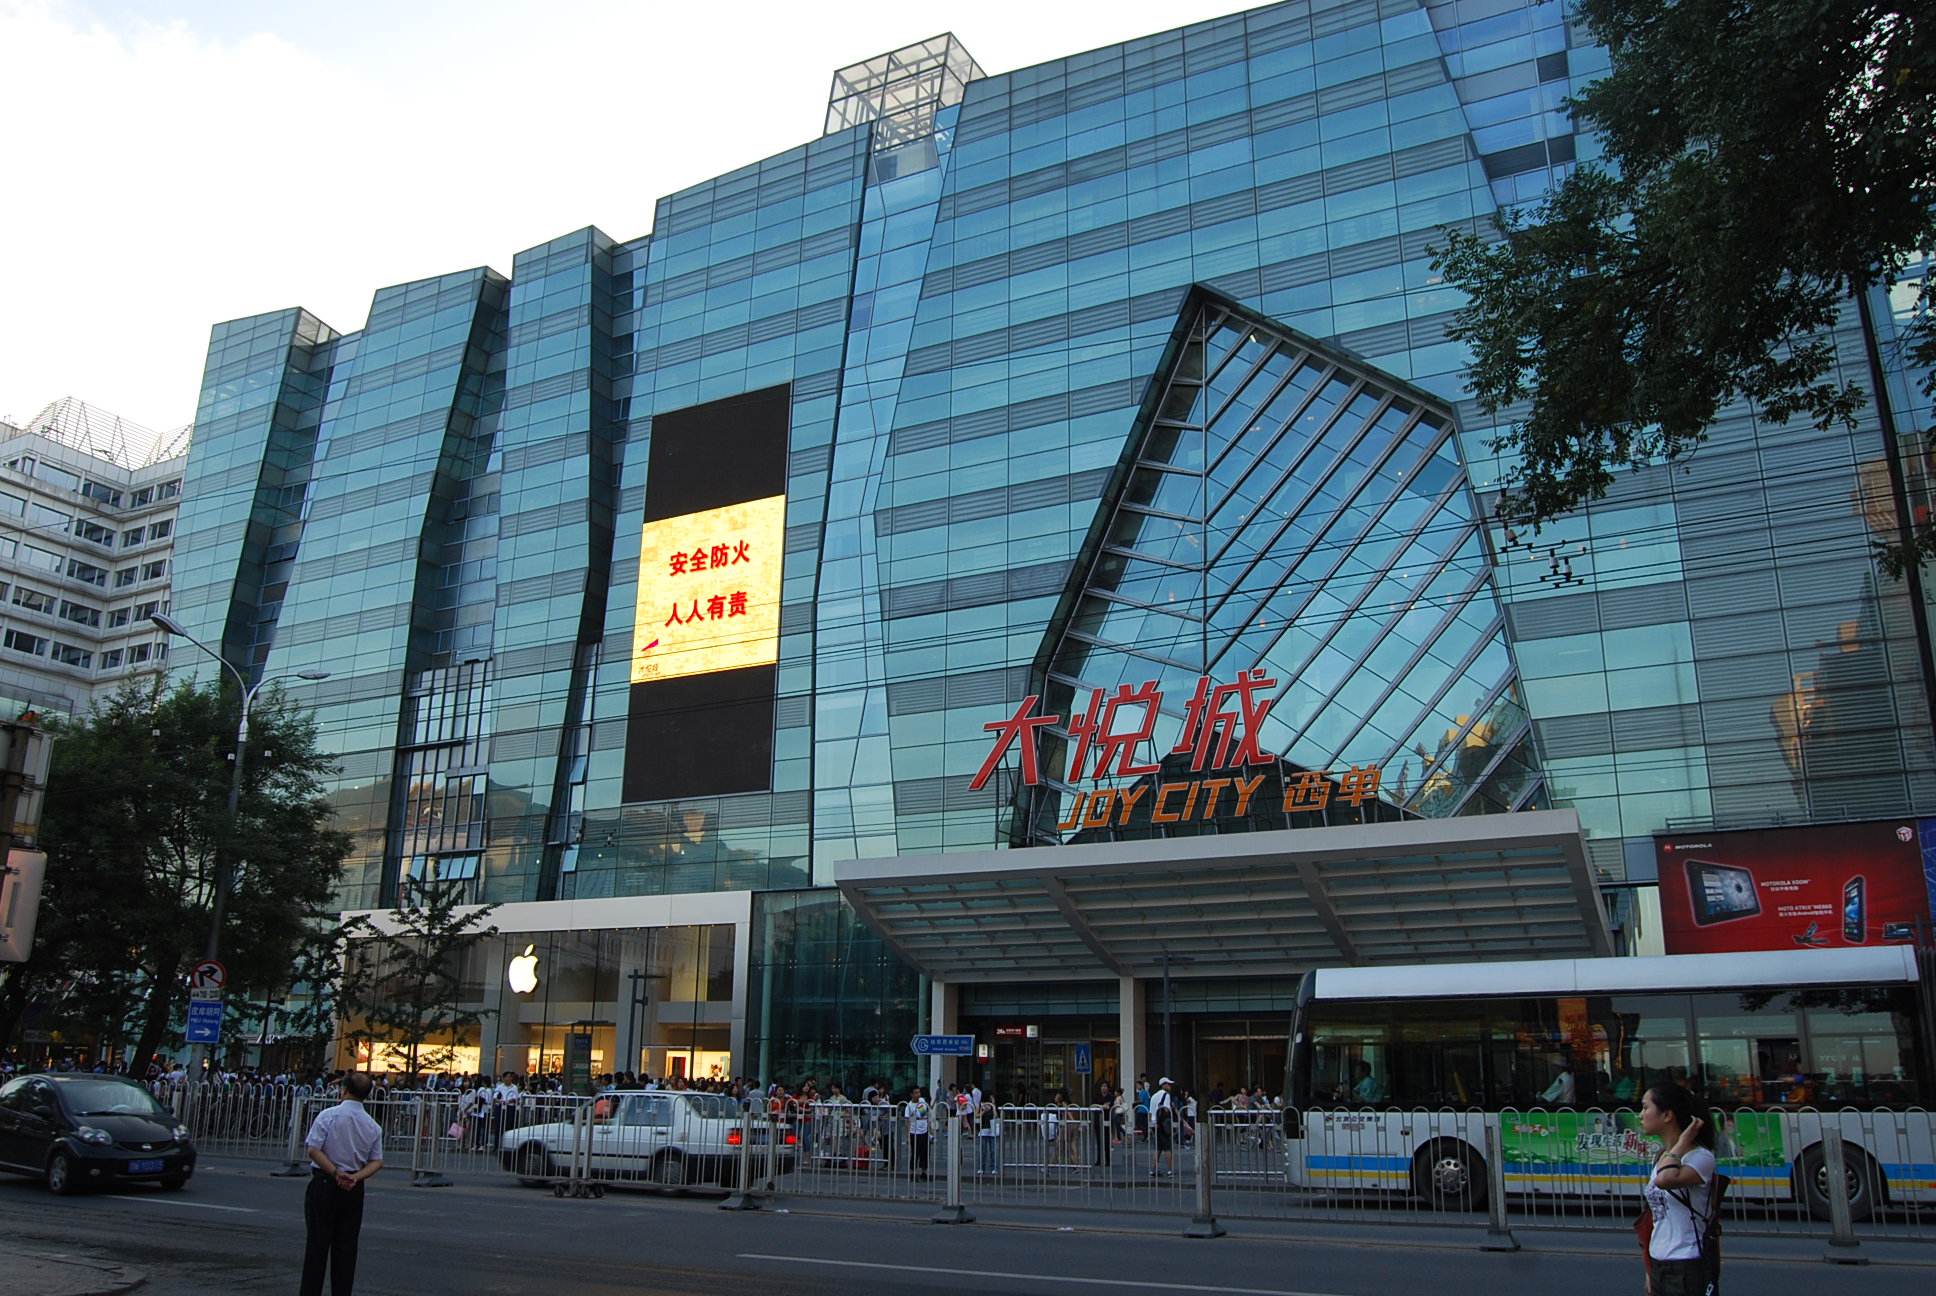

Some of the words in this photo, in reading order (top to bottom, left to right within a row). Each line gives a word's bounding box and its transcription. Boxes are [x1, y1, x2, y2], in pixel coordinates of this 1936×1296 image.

[669, 540, 749, 577] 安全防火
[665, 591, 748, 627] 人人有责
[968, 667, 1278, 791] 大悦城
[1057, 784, 1144, 831] JOY
[1151, 774, 1266, 824] CITY
[1282, 763, 1382, 813] 西单
